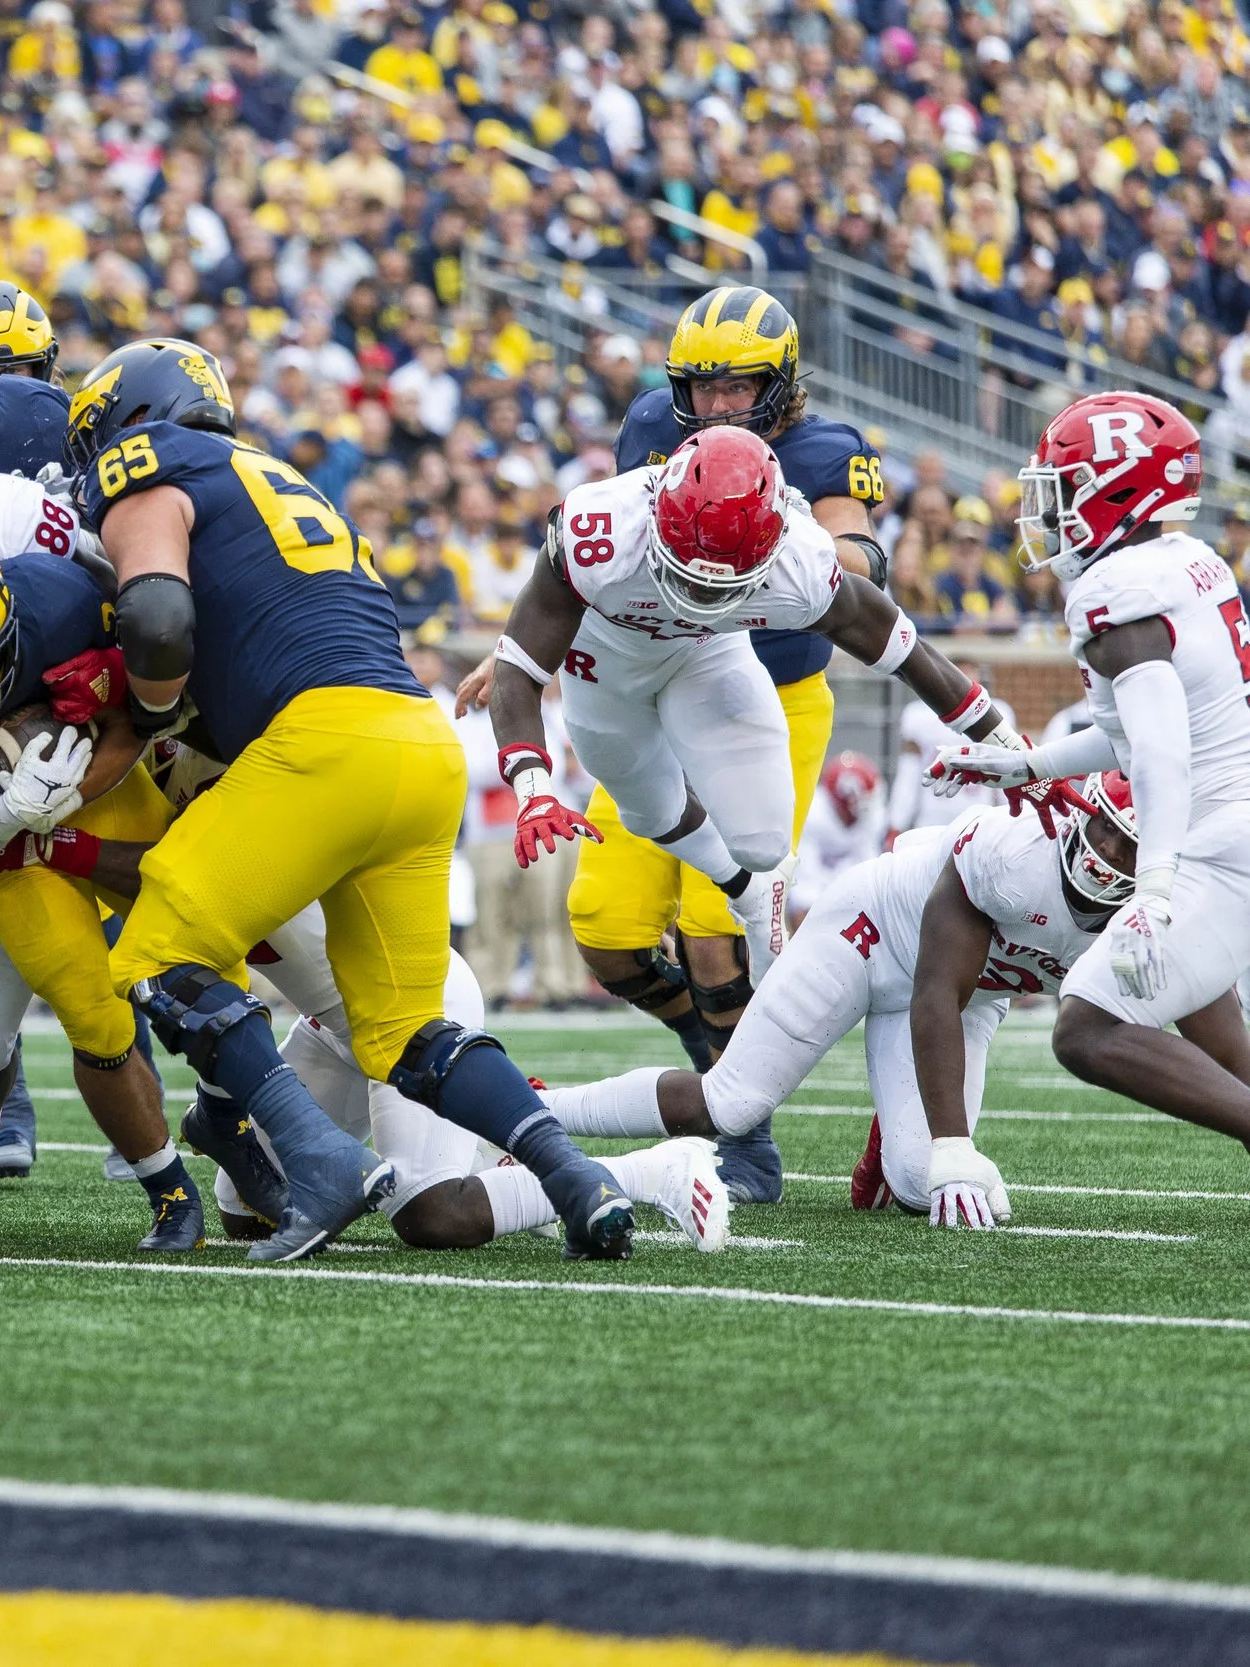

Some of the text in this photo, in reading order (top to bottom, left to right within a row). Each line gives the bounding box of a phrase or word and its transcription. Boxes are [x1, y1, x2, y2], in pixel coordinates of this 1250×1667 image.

[1087, 411, 1153, 463] R
[98, 434, 159, 498] 65
[848, 455, 884, 502] 68
[35, 500, 75, 556] 88
[230, 449, 386, 588] 6
[570, 512, 614, 567] 58
[564, 648, 598, 684] R
[769, 880, 785, 956] ADIZERO
[840, 911, 881, 960] R
